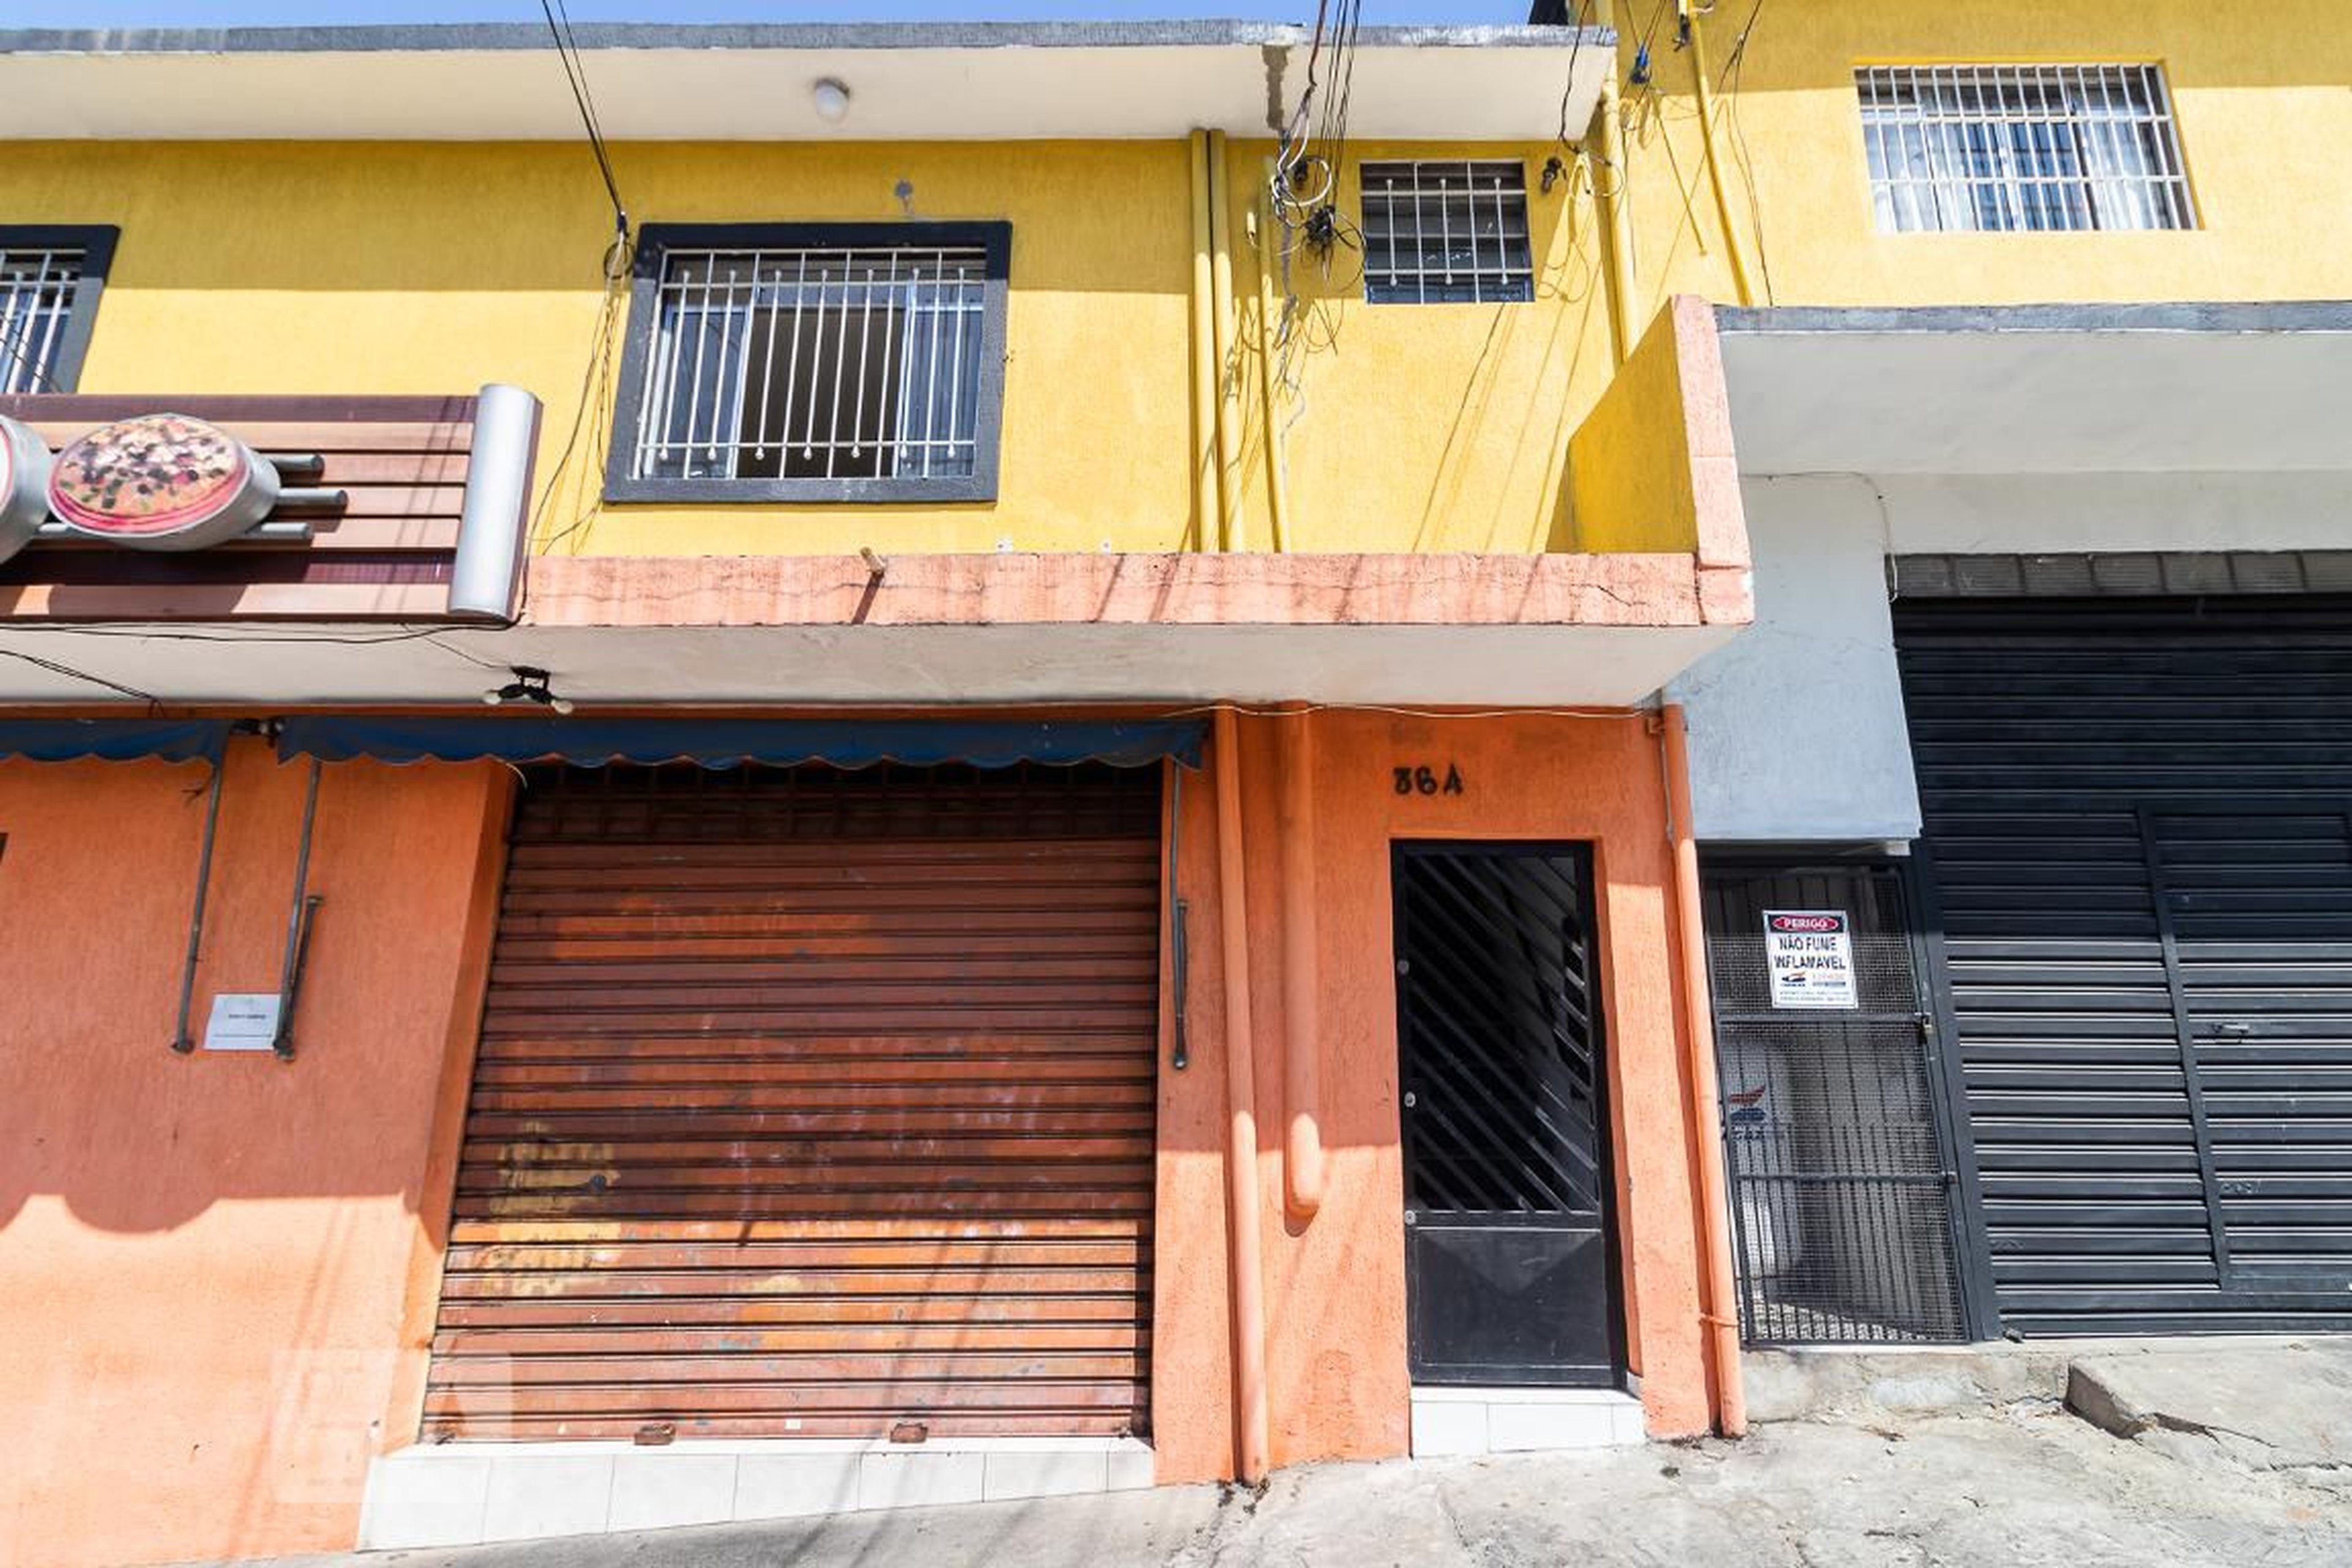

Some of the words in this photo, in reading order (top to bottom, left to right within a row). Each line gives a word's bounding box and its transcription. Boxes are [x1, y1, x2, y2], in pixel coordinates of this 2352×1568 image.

[1784, 918, 1828, 929] PERIGO
[1779, 935, 1804, 950] NÃO
[1806, 937, 1838, 951] FUME
